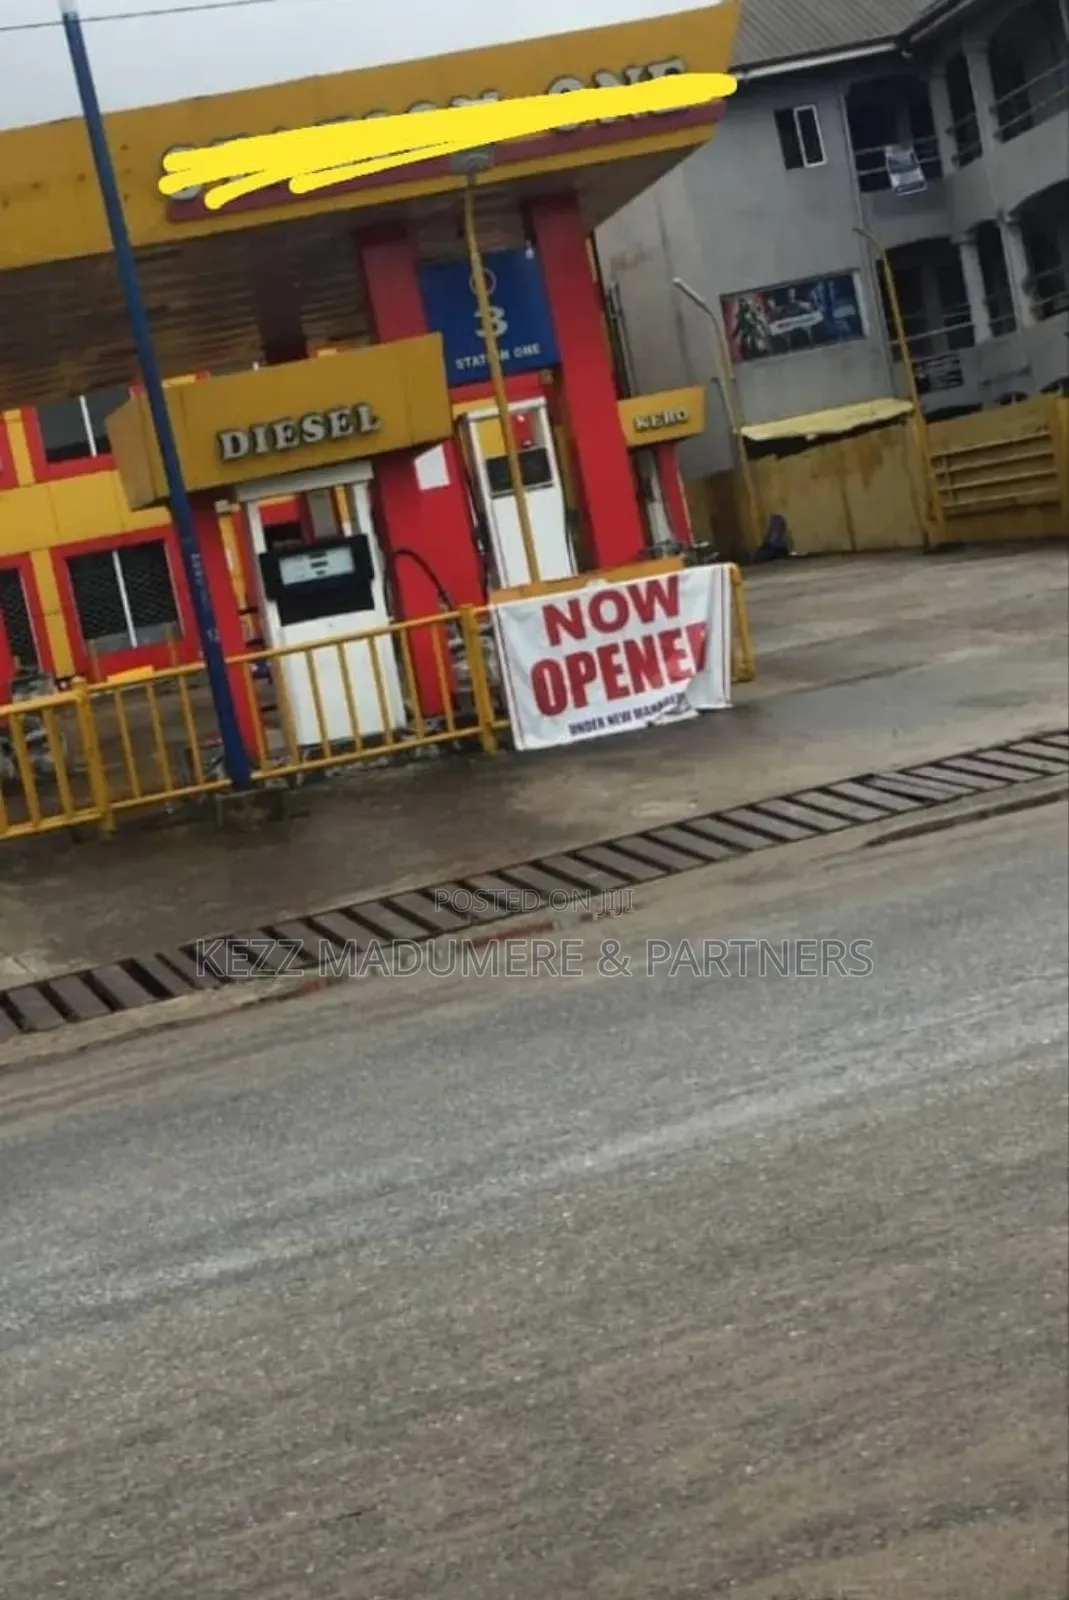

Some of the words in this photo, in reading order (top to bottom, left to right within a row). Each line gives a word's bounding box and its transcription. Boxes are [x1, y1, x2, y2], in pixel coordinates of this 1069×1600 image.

[455, 349, 510, 370] STATN
[218, 402, 381, 461] DIESEL
[541, 574, 680, 647] NOW
[568, 716, 605, 736] UNDER
[606, 709, 632, 727] NEW
